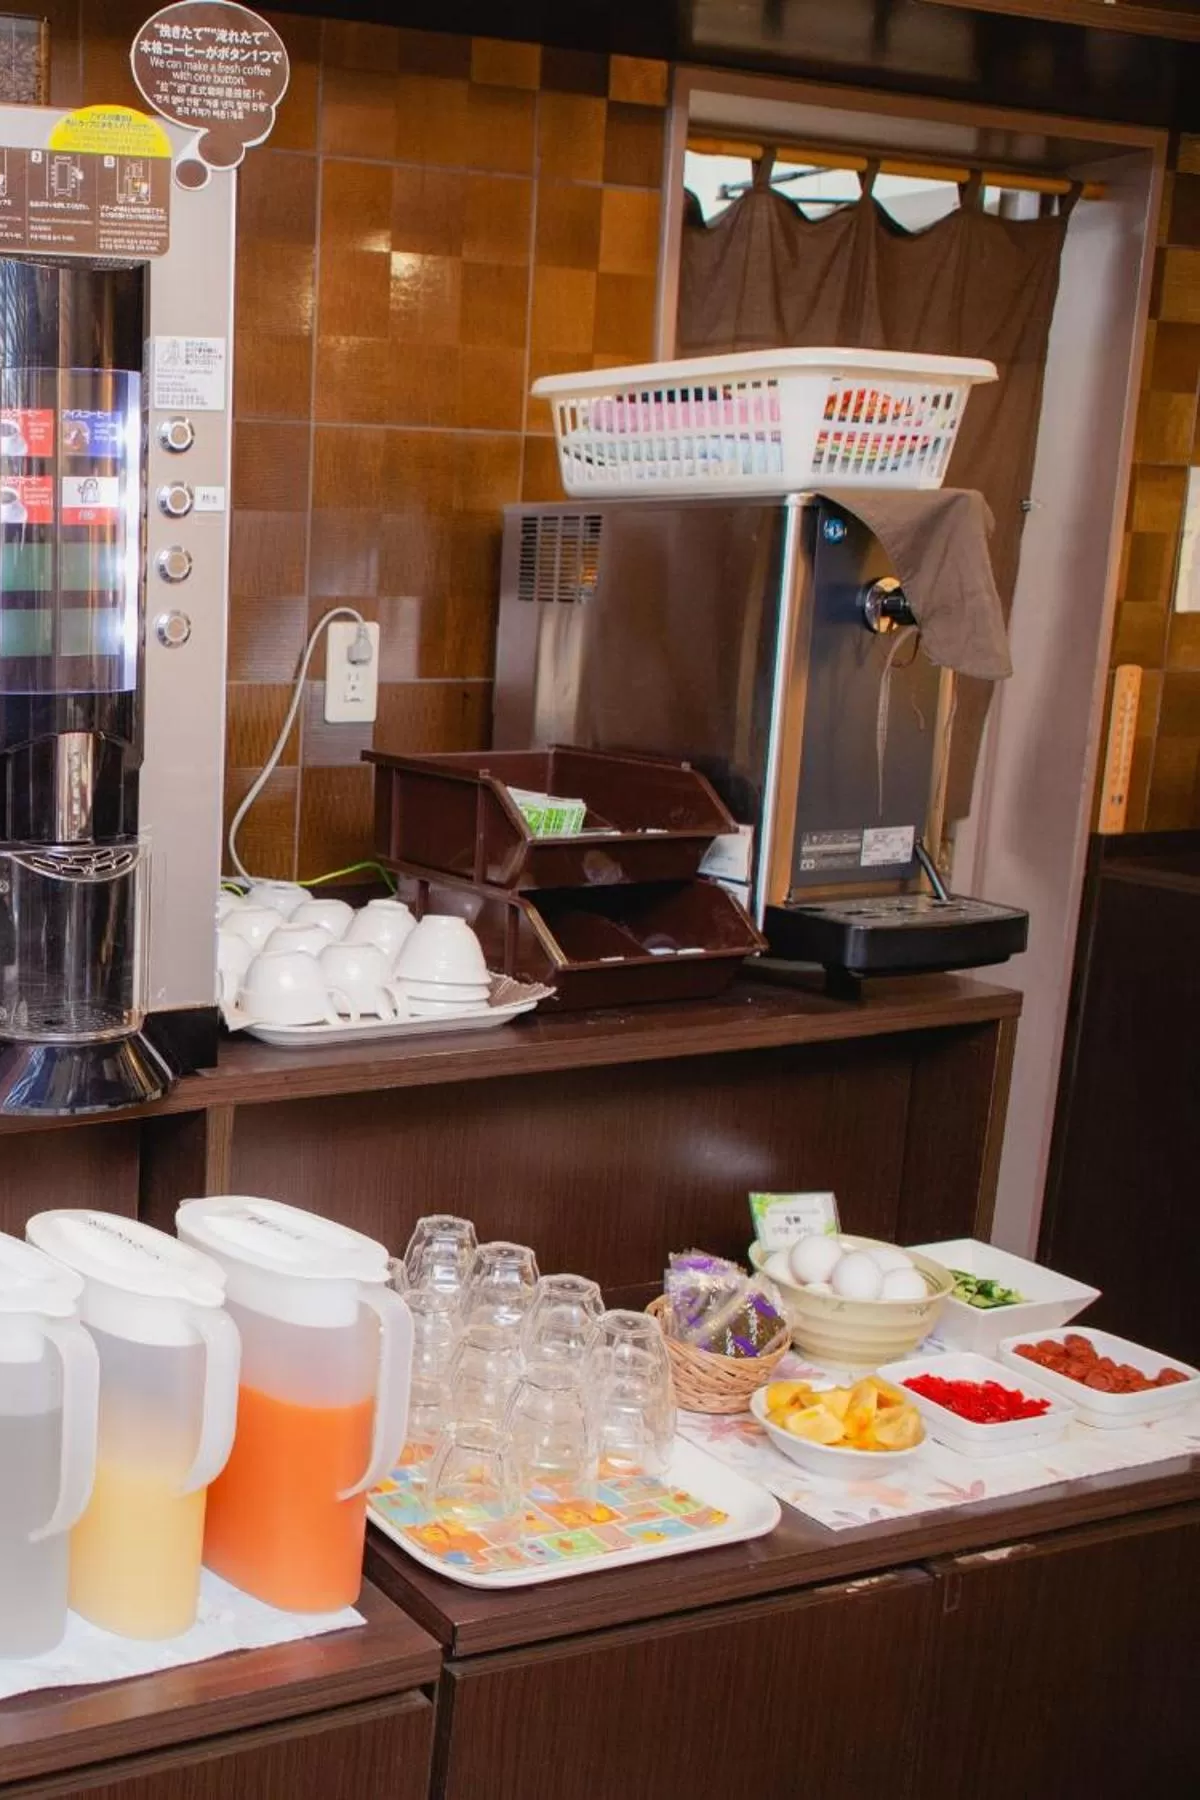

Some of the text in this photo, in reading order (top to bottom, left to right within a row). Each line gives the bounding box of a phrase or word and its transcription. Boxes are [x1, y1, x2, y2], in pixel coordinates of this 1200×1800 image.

[150, 57, 165, 68] We
[167, 61, 182, 70] can
[184, 61, 209, 73] make
[216, 62, 241, 75] fresh
[242, 65, 272, 78] coffee
[172, 71, 192, 82] with
[193, 74, 212, 84] one
